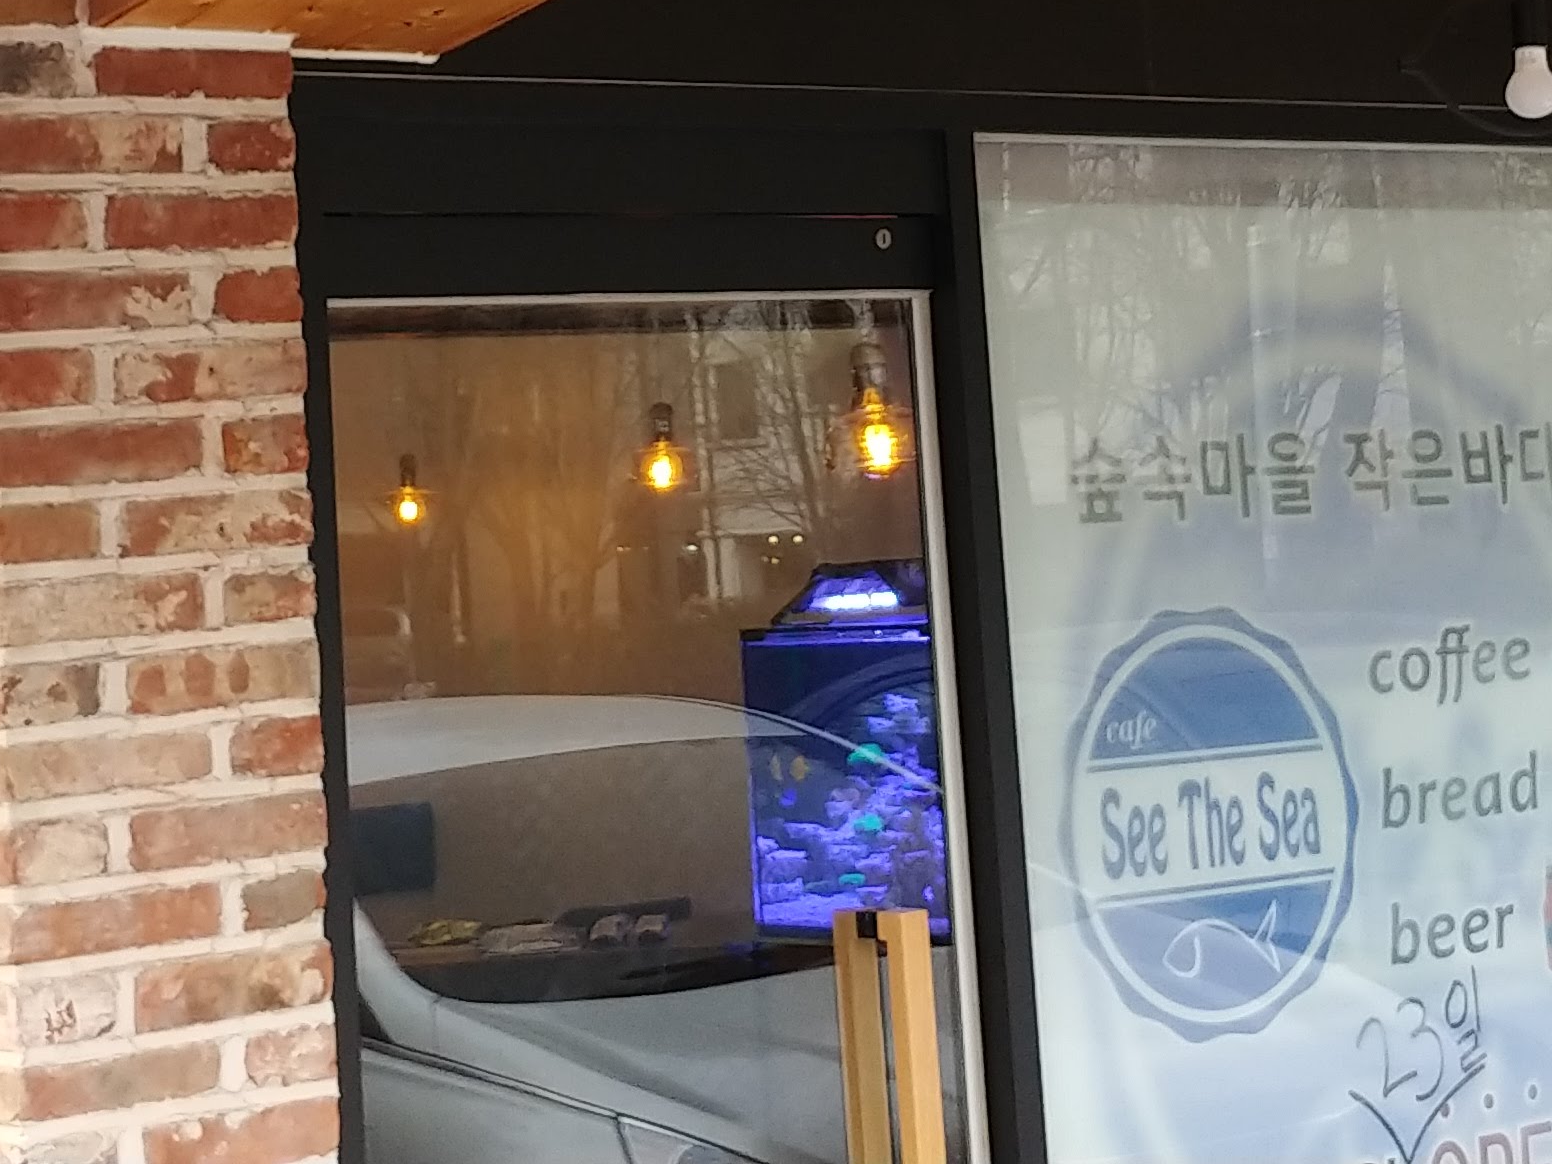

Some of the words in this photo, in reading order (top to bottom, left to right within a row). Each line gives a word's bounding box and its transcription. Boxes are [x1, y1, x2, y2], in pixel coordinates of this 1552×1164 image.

[1070, 430, 1317, 524] 숲속마을
[1369, 624, 1531, 706] coffee
[1105, 712, 1157, 753] cafe
[1101, 788, 1168, 880] See
[1178, 779, 1245, 872] The
[1255, 770, 1321, 860] Sea
[1382, 753, 1538, 830] bread
[1390, 900, 1515, 965] beer
